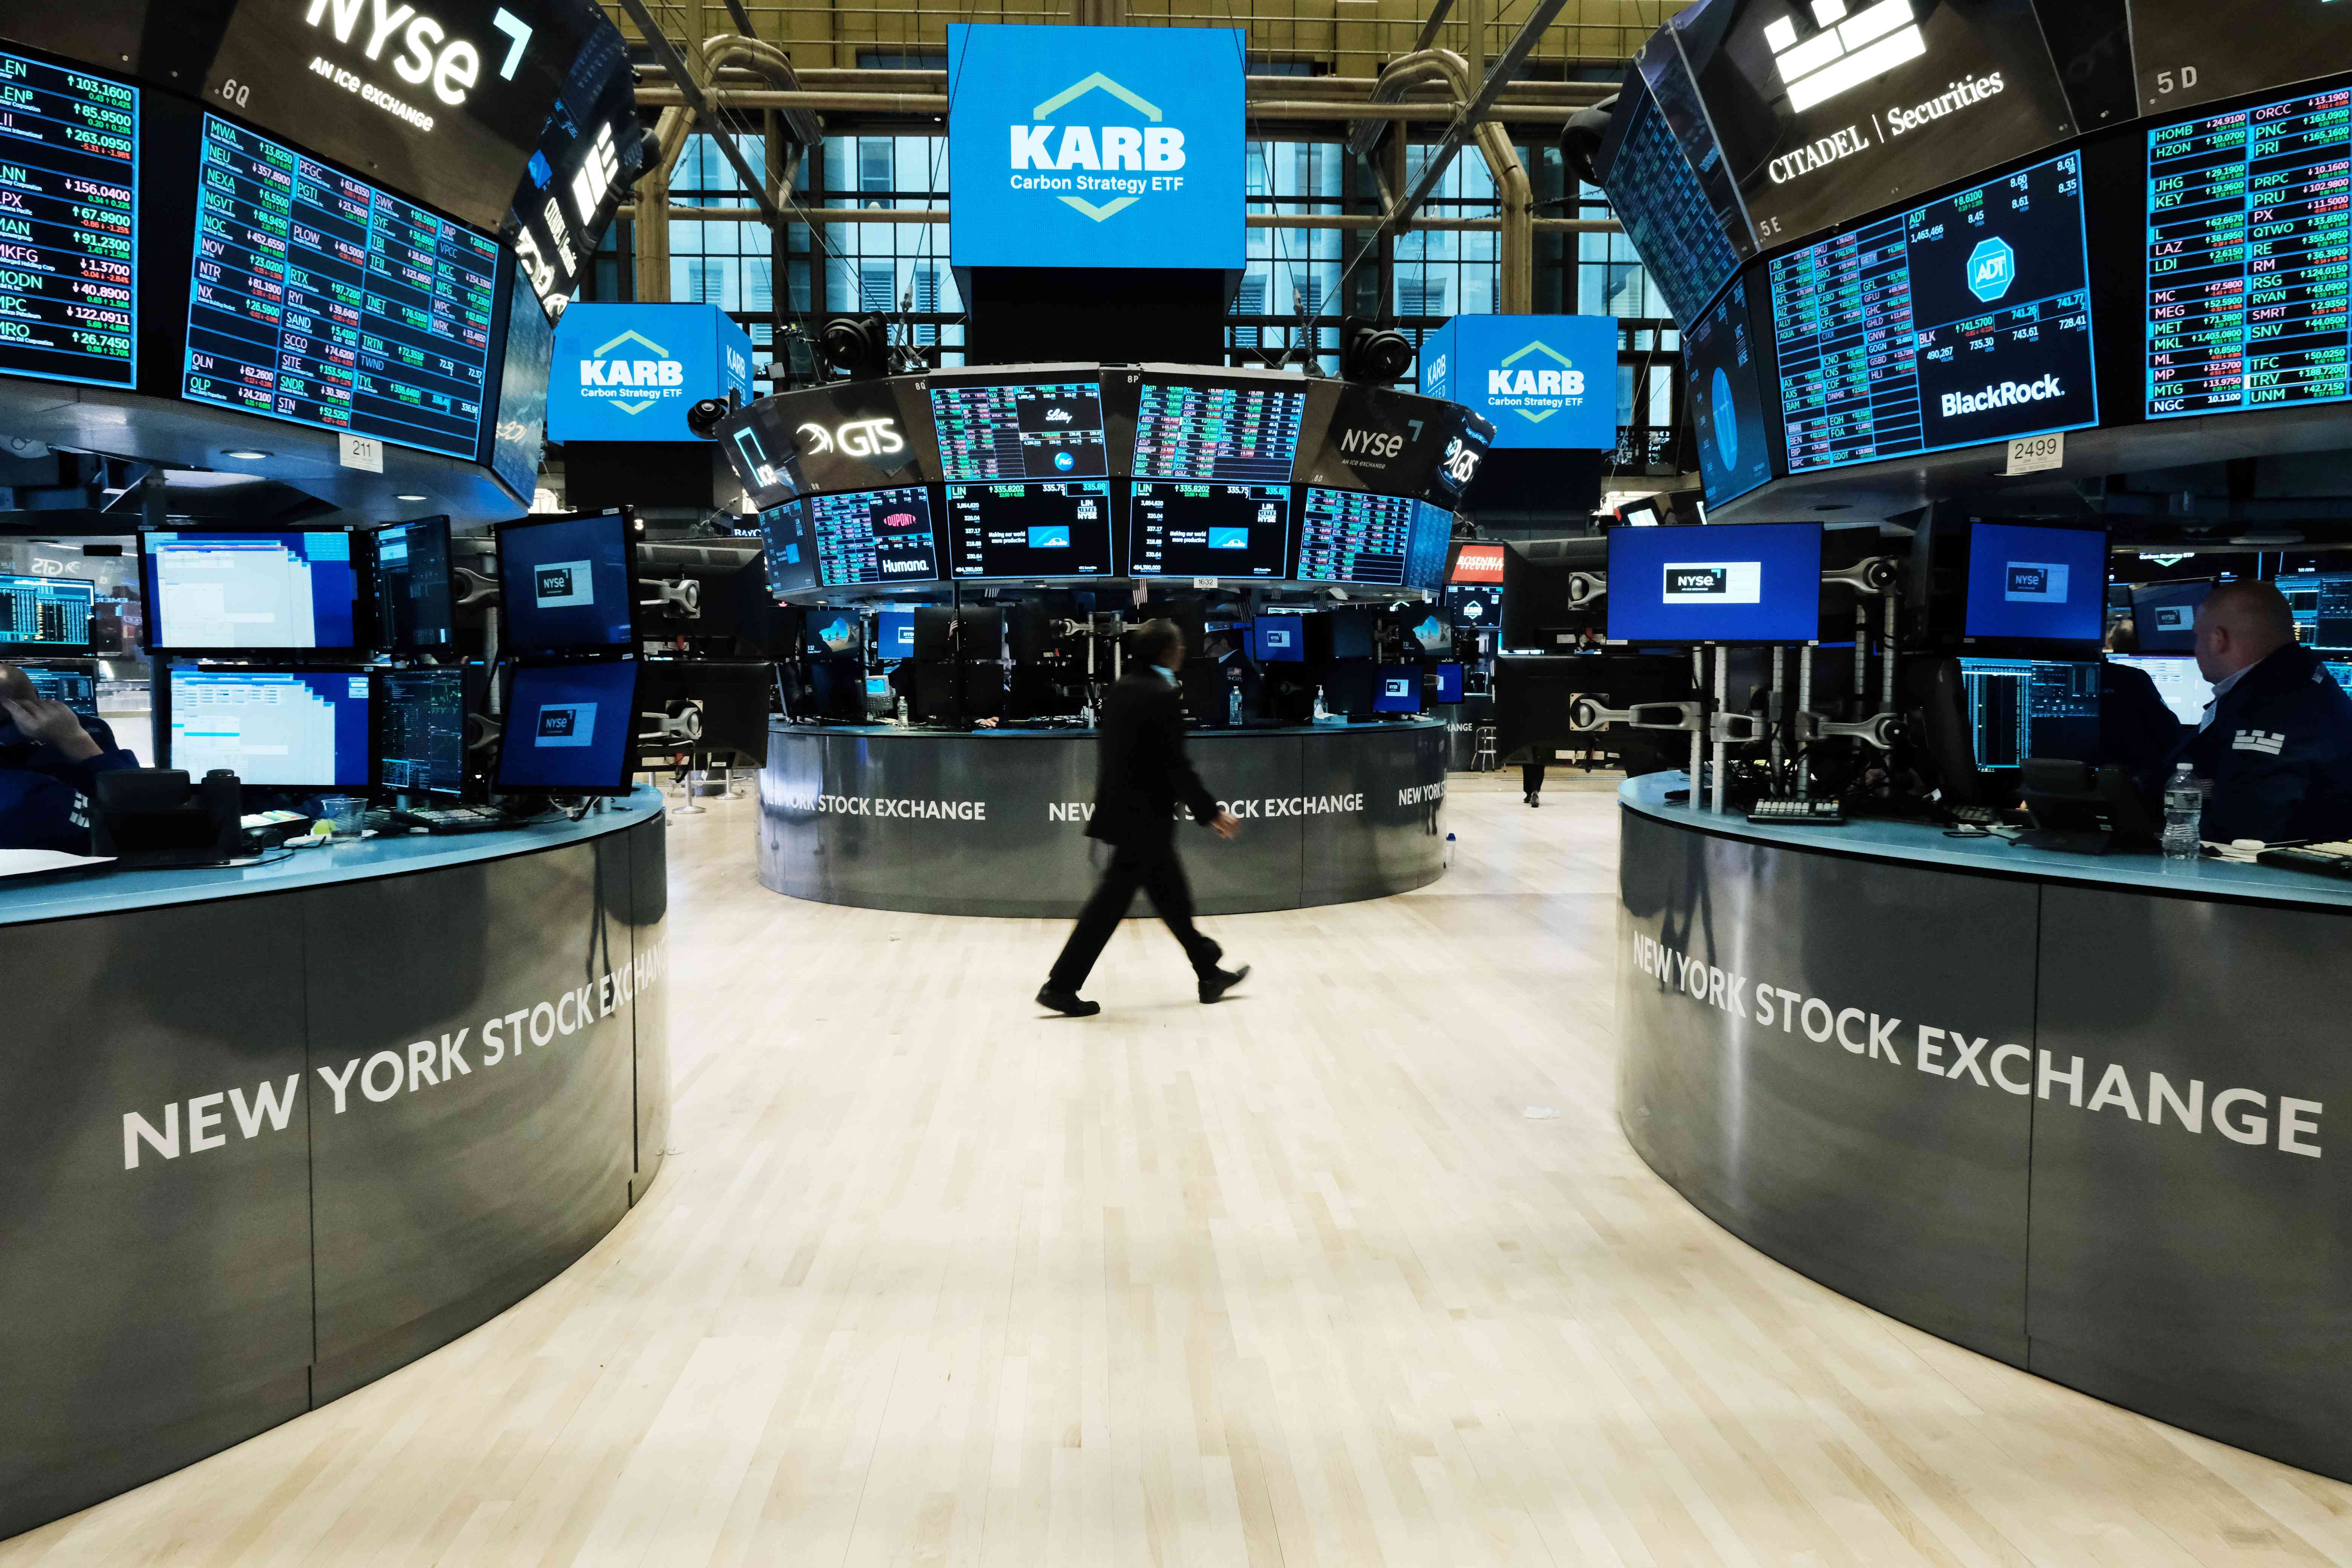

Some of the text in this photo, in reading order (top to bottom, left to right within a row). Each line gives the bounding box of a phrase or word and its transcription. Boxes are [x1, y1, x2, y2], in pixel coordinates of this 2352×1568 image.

[309, 57, 333, 82] AN
[76, 77, 131, 101] 103.1600
[223, 79, 250, 108] 6Q
[2315, 92, 2349, 104] 13.1900
[83, 106, 131, 127] 85.9500
[2256, 104, 2291, 120] ORCC
[1769, 72, 2004, 184] CITADEL Securities
[2213, 114, 2245, 127] 24.9100
[211, 121, 236, 142] MWA
[2156, 125, 2193, 142] HOMB
[2256, 122, 2287, 138] PNC
[209, 144, 230, 163] NEU
[1011, 126, 1186, 171] KARB
[2156, 142, 2191, 158] HZON
[300, 160, 323, 179] PFGC
[2057, 157, 2075, 171] 8.61
[207, 168, 235, 190] NEXA
[1011, 175, 1184, 194] Carbon Strategy ETF
[2010, 174, 2027, 187] 8.60
[2058, 179, 2076, 193] 8.35
[2156, 177, 2184, 192] JHG
[74, 180, 130, 202] 156.0400
[1959, 189, 1983, 205] 8.6100
[2254, 191, 2285, 206] PRU
[206, 191, 234, 212] NGVT
[2012, 196, 2029, 208] 8.61
[2156, 193, 2184, 208] KEY
[81, 208, 130, 227] 67.9900
[204, 215, 226, 233] NOC
[1909, 210, 1926, 225] ADT
[1968, 210, 1984, 224] 8.45
[1911, 225, 1943, 243] 1,463,466
[2253, 223, 2293, 238] QTWO
[82, 233, 130, 251] 91.2300
[202, 238, 224, 255] NOV
[2156, 241, 2182, 256] LAZ
[440, 243, 458, 259] VPCC
[89, 260, 130, 276] 1.3700
[200, 261, 220, 278] NTR
[1976, 255, 2005, 283] ADT
[2155, 259, 2177, 272] LDI
[291, 269, 309, 284] RTX
[81, 283, 129, 300] 40.8900
[2253, 291, 2286, 305] RYAN
[367, 295, 387, 310] TNET
[286, 312, 311, 328] SAND
[2155, 305, 2185, 319] MEG
[2252, 307, 2286, 320] SMRT
[2059, 315, 2086, 330] 728.41
[2155, 321, 2182, 335] MET
[81, 332, 129, 349] 26.7450
[1780, 330, 1794, 340] AQUA
[1919, 331, 1936, 344] BLK
[2013, 327, 2038, 340] 743.61
[2154, 337, 2183, 350] MKL
[192, 354, 213, 369] OLN
[361, 355, 384, 371] TWND
[727, 345, 746, 380] KARB
[1824, 355, 1839, 366] CNO
[580, 360, 683, 386] KARB
[1428, 354, 1446, 388] KARB
[915, 382, 926, 390] 8Q
[1488, 370, 1584, 395] KARB
[581, 389, 617, 397] Carbon
[619, 389, 661, 399] Strategy
[2251, 389, 2285, 403] UNM
[1488, 397, 1583, 408] Carbon Strategy ETF
[2154, 400, 2184, 412] NGC
[1046, 409, 1072, 424] Lilly
[837, 419, 903, 456] GTS
[353, 440, 371, 457] 211
[2015, 439, 2056, 459] 2499
[1452, 450, 1479, 482] GTS
[952, 487, 966, 495] LIN
[1138, 484, 1152, 492] LIN
[887, 513, 913, 527] DUPONT
[882, 560, 929, 573] Humana.
[1457, 556, 1504, 564] ROSENBLA
[1399, 782, 1440, 806] NEW YORK
[784, 792, 816, 810] YORK
[818, 795, 871, 816] STOCK
[875, 798, 986, 821] EXCHANGE
[1265, 793, 1363, 817] EXCHANGE
[1634, 931, 2323, 1159] NEW YORK STOCK EXCHANGE
[123, 1073, 300, 1170] NEW
[317, 1027, 472, 1114] YORK
[482, 982, 595, 1066] STOCK
